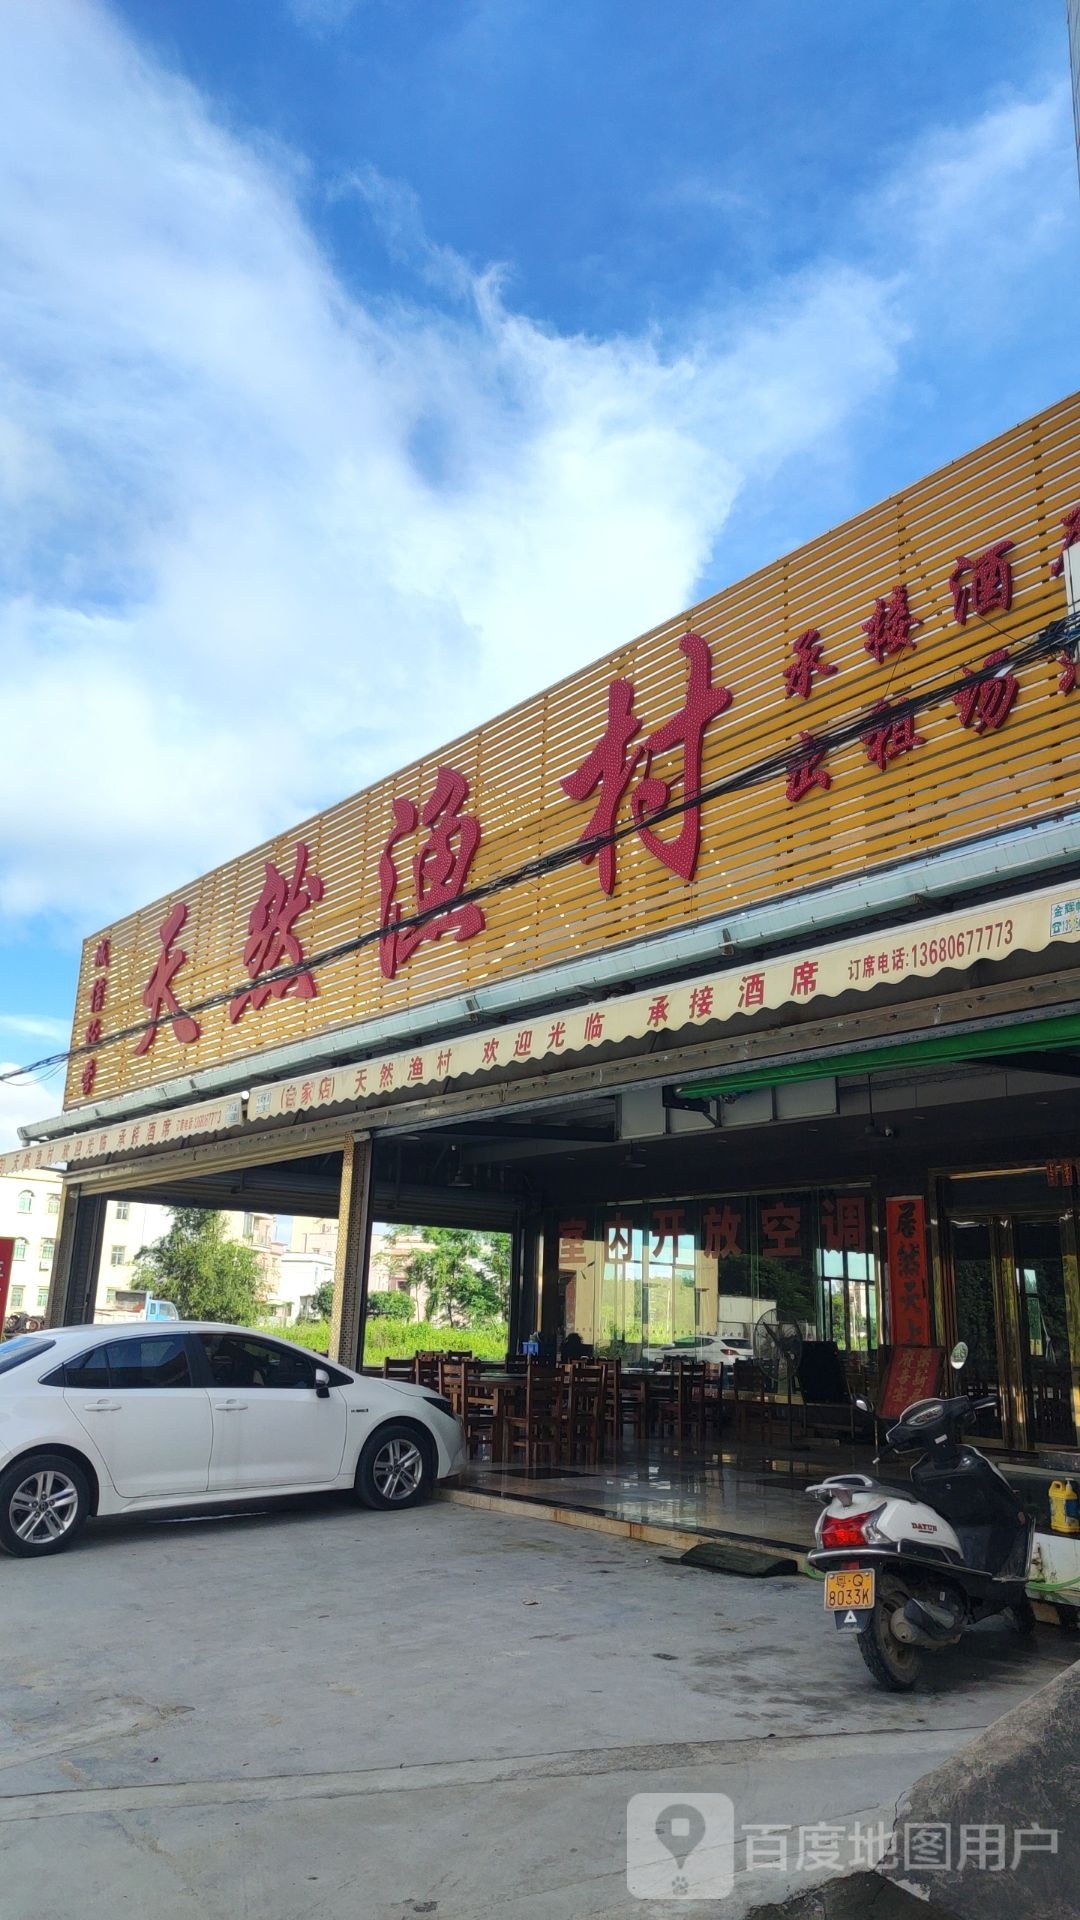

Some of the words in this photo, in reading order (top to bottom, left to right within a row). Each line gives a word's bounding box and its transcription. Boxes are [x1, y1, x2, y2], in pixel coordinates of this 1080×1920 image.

[785, 650, 1080, 803] 出租场
[354, 1048, 453, 1094] 天然渔村
[482, 1012, 606, 1064] 欢迎光临
[647, 961, 819, 1027] 承接酒席
[558, 1197, 867, 1264] 室内开放空调
[829, 1588, 870, 1607] 8033K
